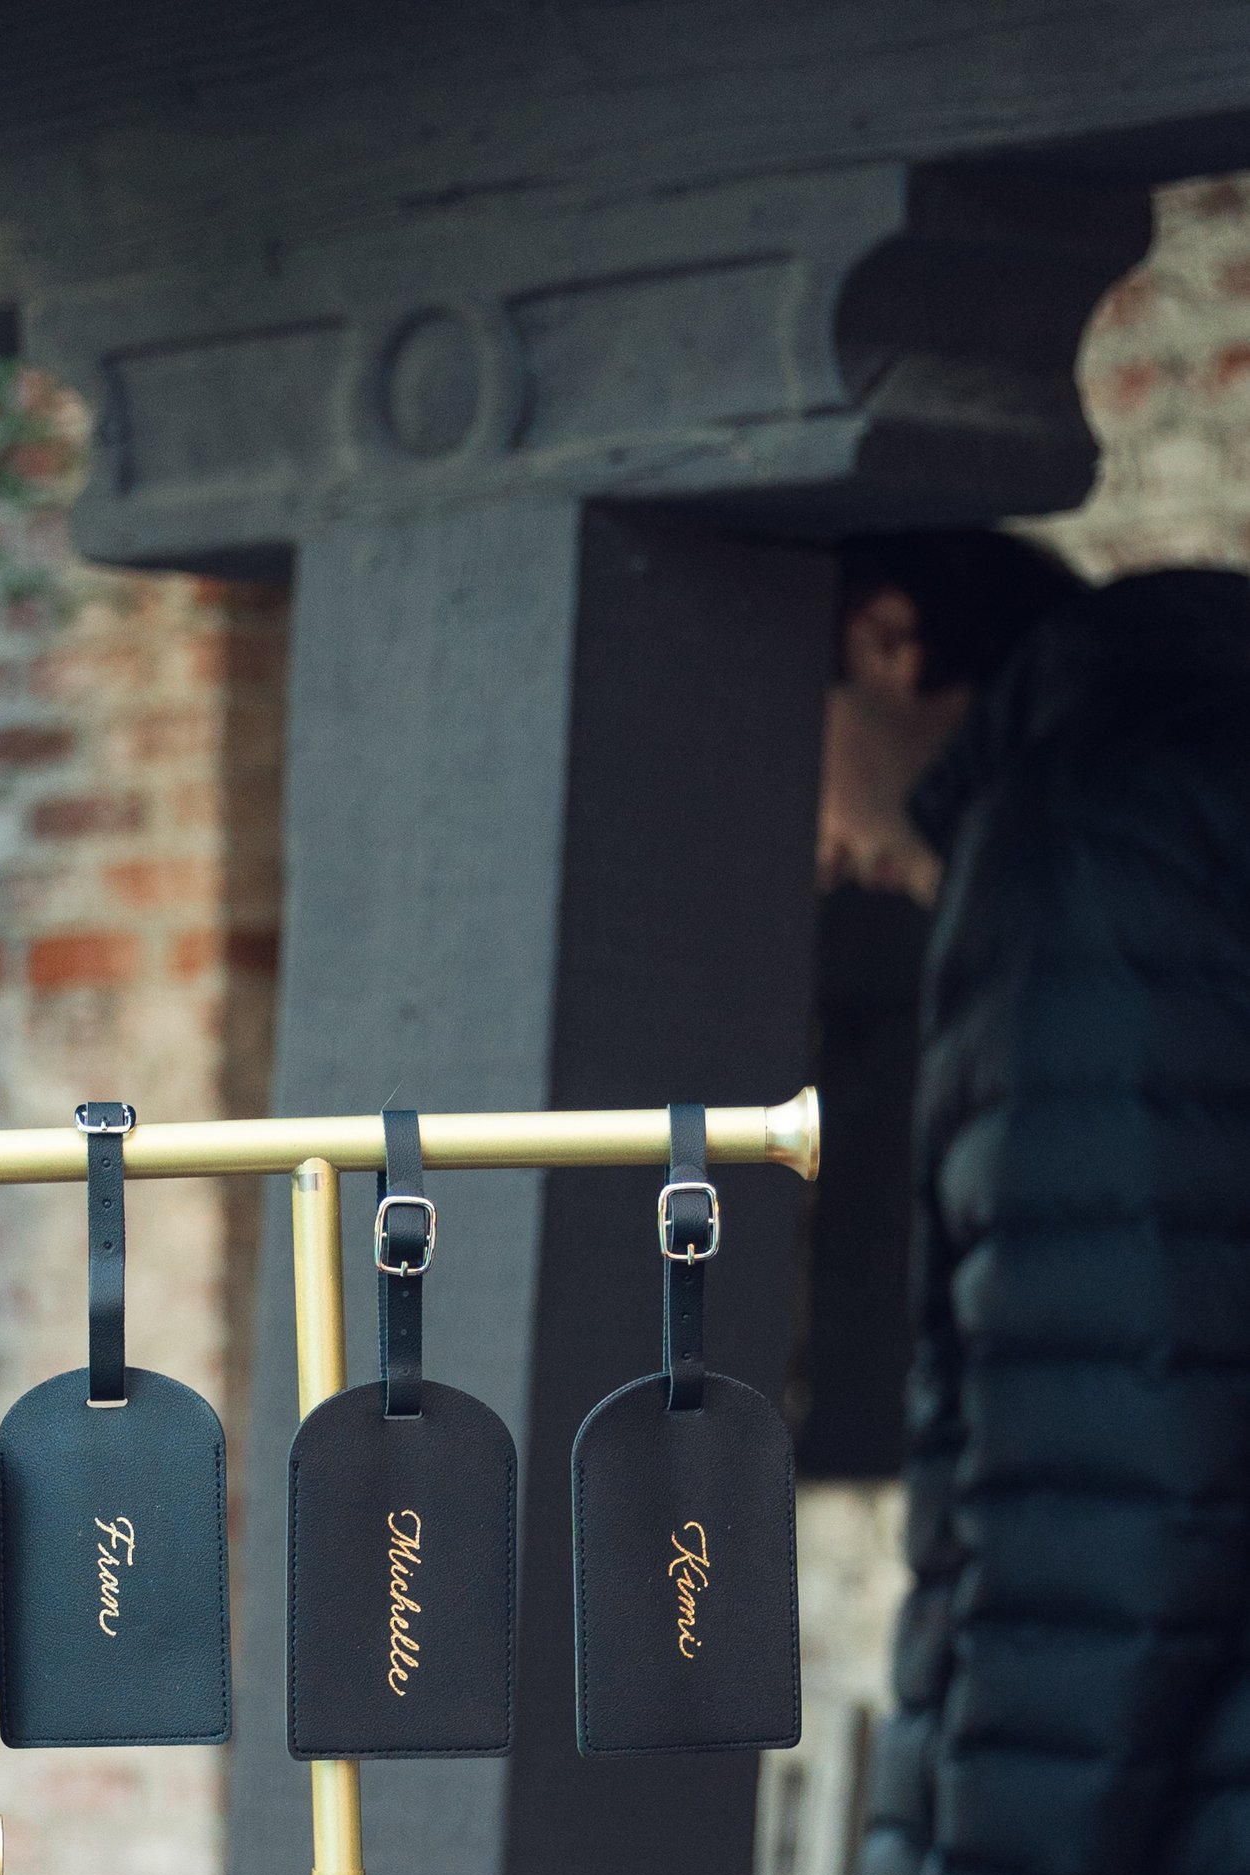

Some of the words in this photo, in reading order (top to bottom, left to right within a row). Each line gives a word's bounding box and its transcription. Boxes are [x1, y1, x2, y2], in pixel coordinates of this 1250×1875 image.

[95, 1515, 136, 1637] Fran
[387, 1508, 422, 1697] Michelle
[668, 1520, 711, 1659] Kimi
